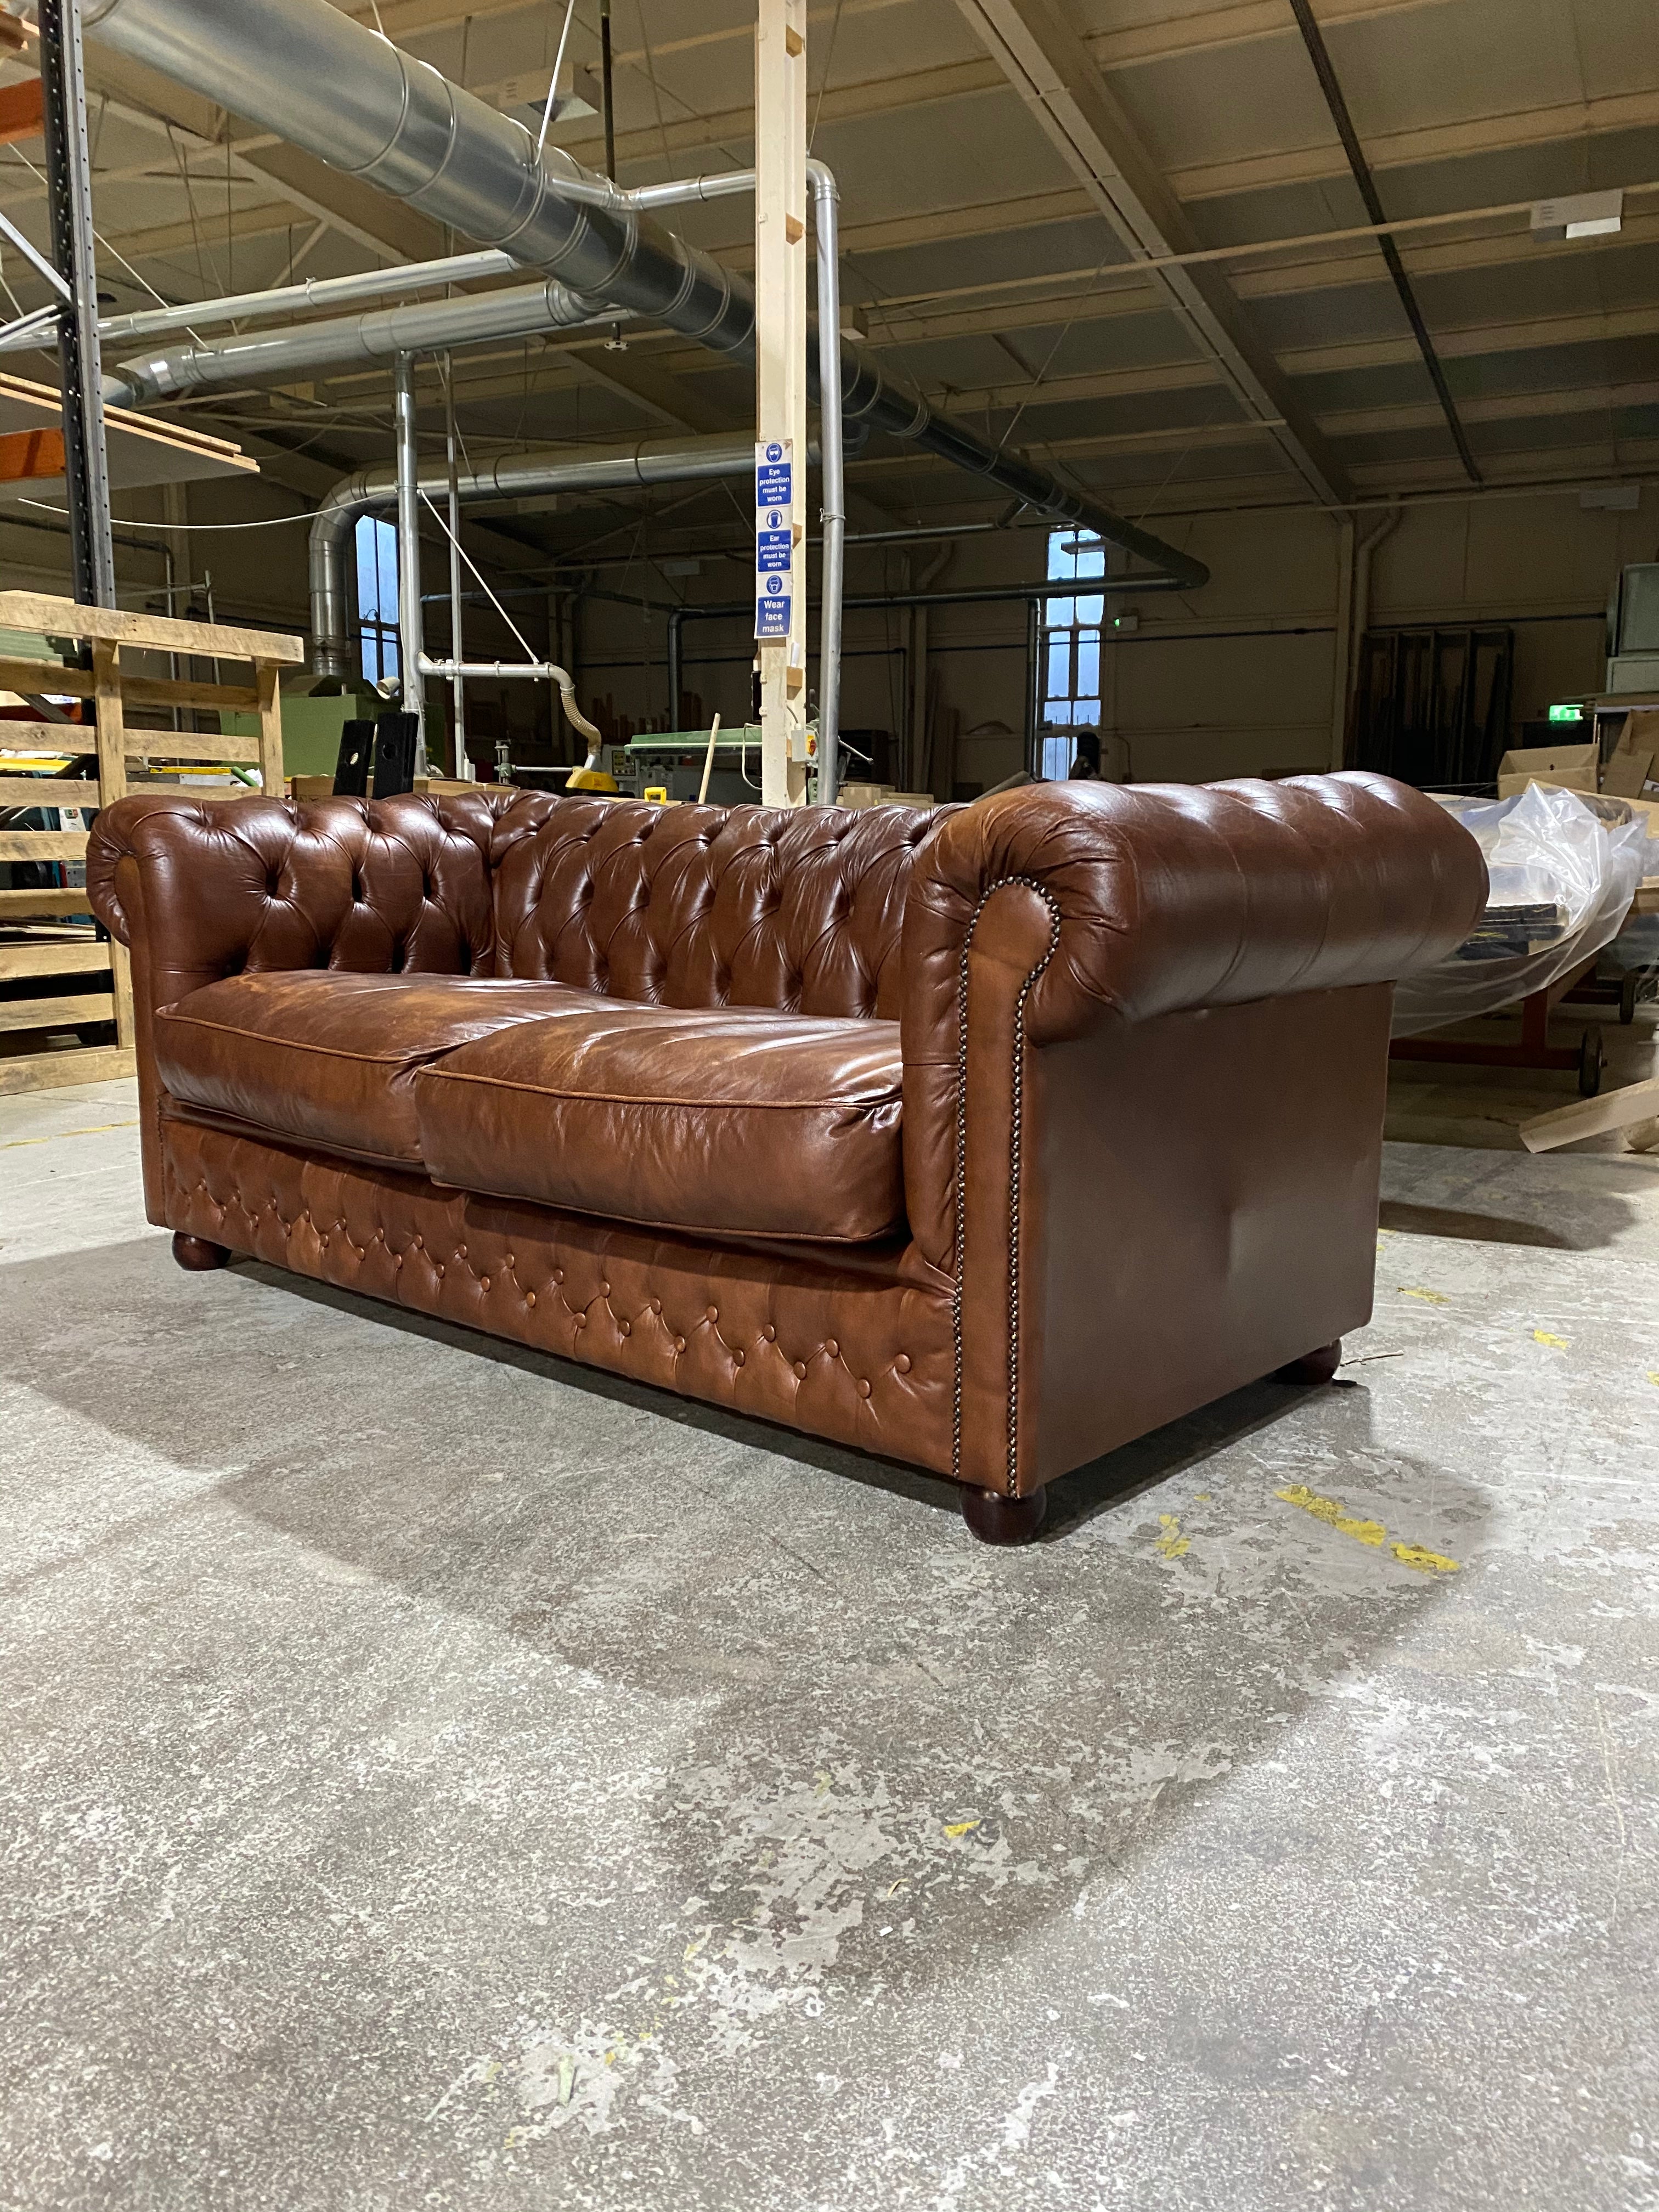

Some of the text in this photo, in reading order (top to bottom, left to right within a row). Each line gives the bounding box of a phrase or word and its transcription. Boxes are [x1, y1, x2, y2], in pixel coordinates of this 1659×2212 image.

[759, 477, 789, 487] protection
[760, 543, 789, 552] protection
[764, 600, 785, 609] Wear
[765, 612, 783, 620] face
[763, 624, 784, 633] mask
